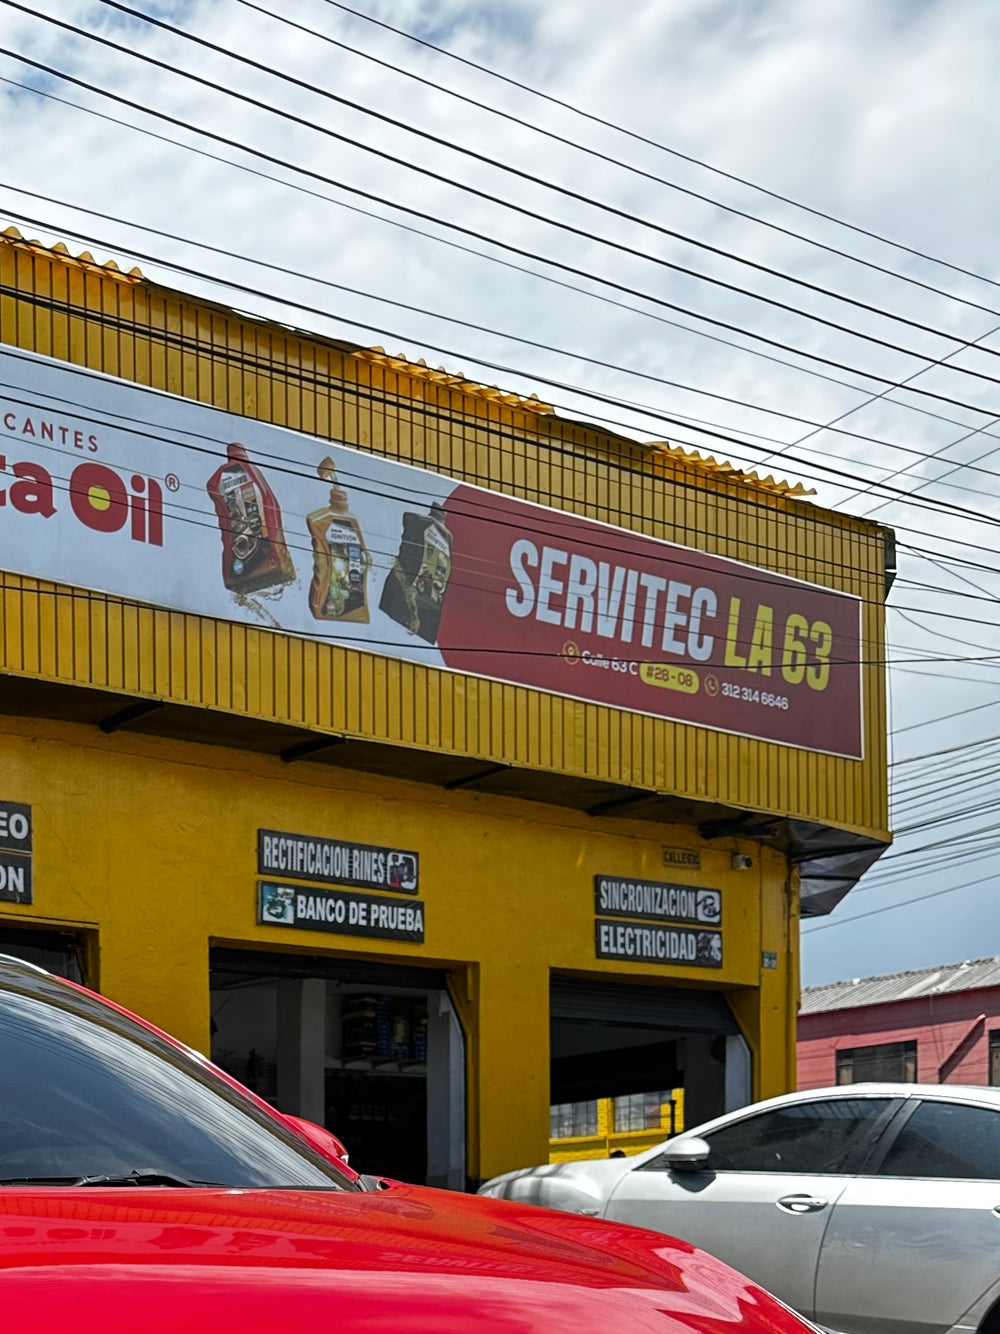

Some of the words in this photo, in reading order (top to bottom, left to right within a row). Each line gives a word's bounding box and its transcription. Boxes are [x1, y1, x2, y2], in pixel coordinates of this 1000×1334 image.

[505, 538, 717, 662] SERVITEC
[724, 596, 775, 677] LA
[782, 612, 834, 692] 63
[581, 650, 610, 669] Calle
[611, 656, 628, 673] 63
[629, 660, 639, 676] C
[263, 835, 350, 879] RECTIFICACION
[352, 849, 385, 884] RINES
[296, 895, 346, 924] BANCO
[348, 901, 368, 926] DE
[370, 904, 424, 933] PRUEBA
[600, 880, 696, 918] SINCRONIZACION
[600, 925, 697, 961] ELECTRICIDAD
